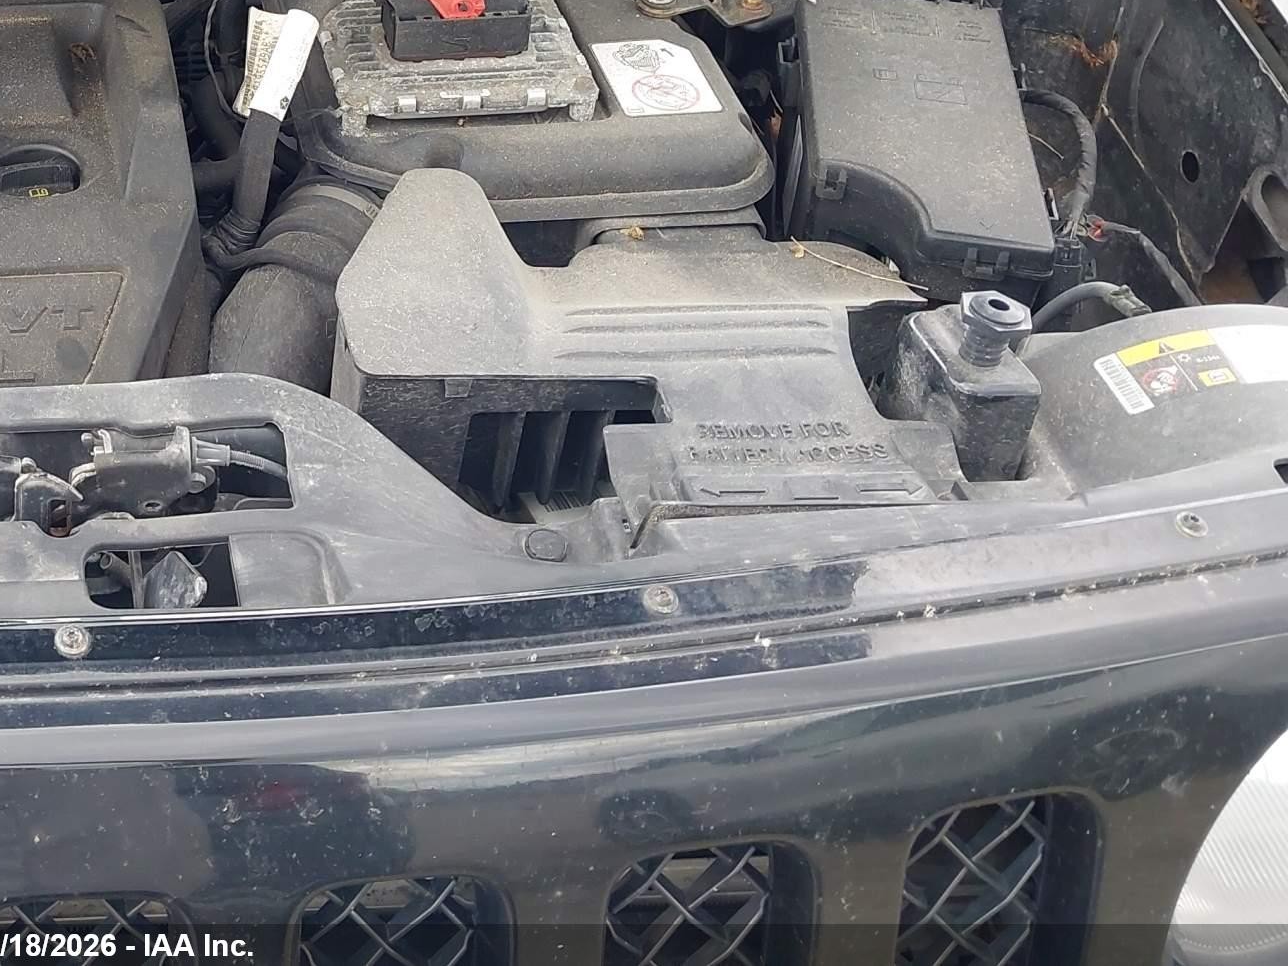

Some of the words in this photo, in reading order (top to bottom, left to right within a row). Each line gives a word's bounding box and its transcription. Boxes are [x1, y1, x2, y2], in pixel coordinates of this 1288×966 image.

[696, 423, 794, 440] REMOVE
[798, 421, 852, 438] FOR
[797, 442, 891, 461] ACCESS
